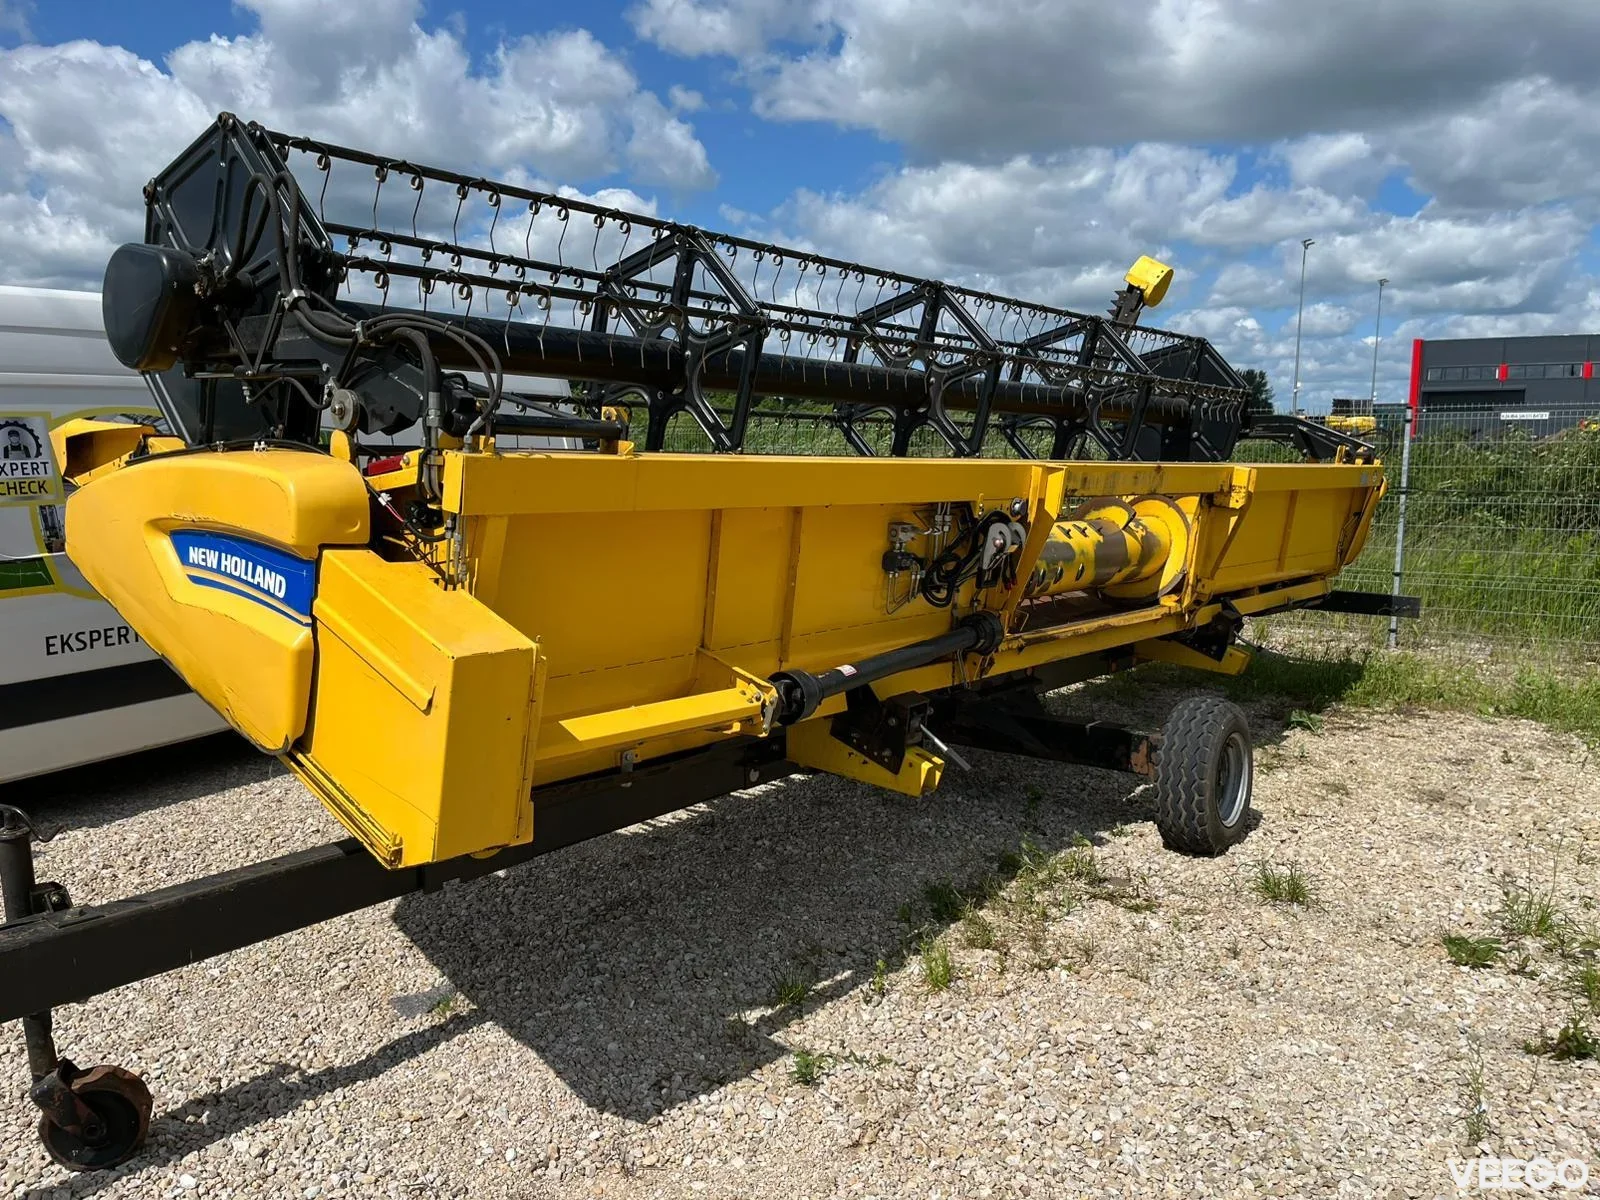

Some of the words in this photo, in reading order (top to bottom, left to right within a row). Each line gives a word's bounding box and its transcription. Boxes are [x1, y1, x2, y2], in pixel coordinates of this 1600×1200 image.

[0, 480, 48, 496] CHECK
[188, 545, 219, 569] NEW
[220, 552, 287, 599] HOLLAND
